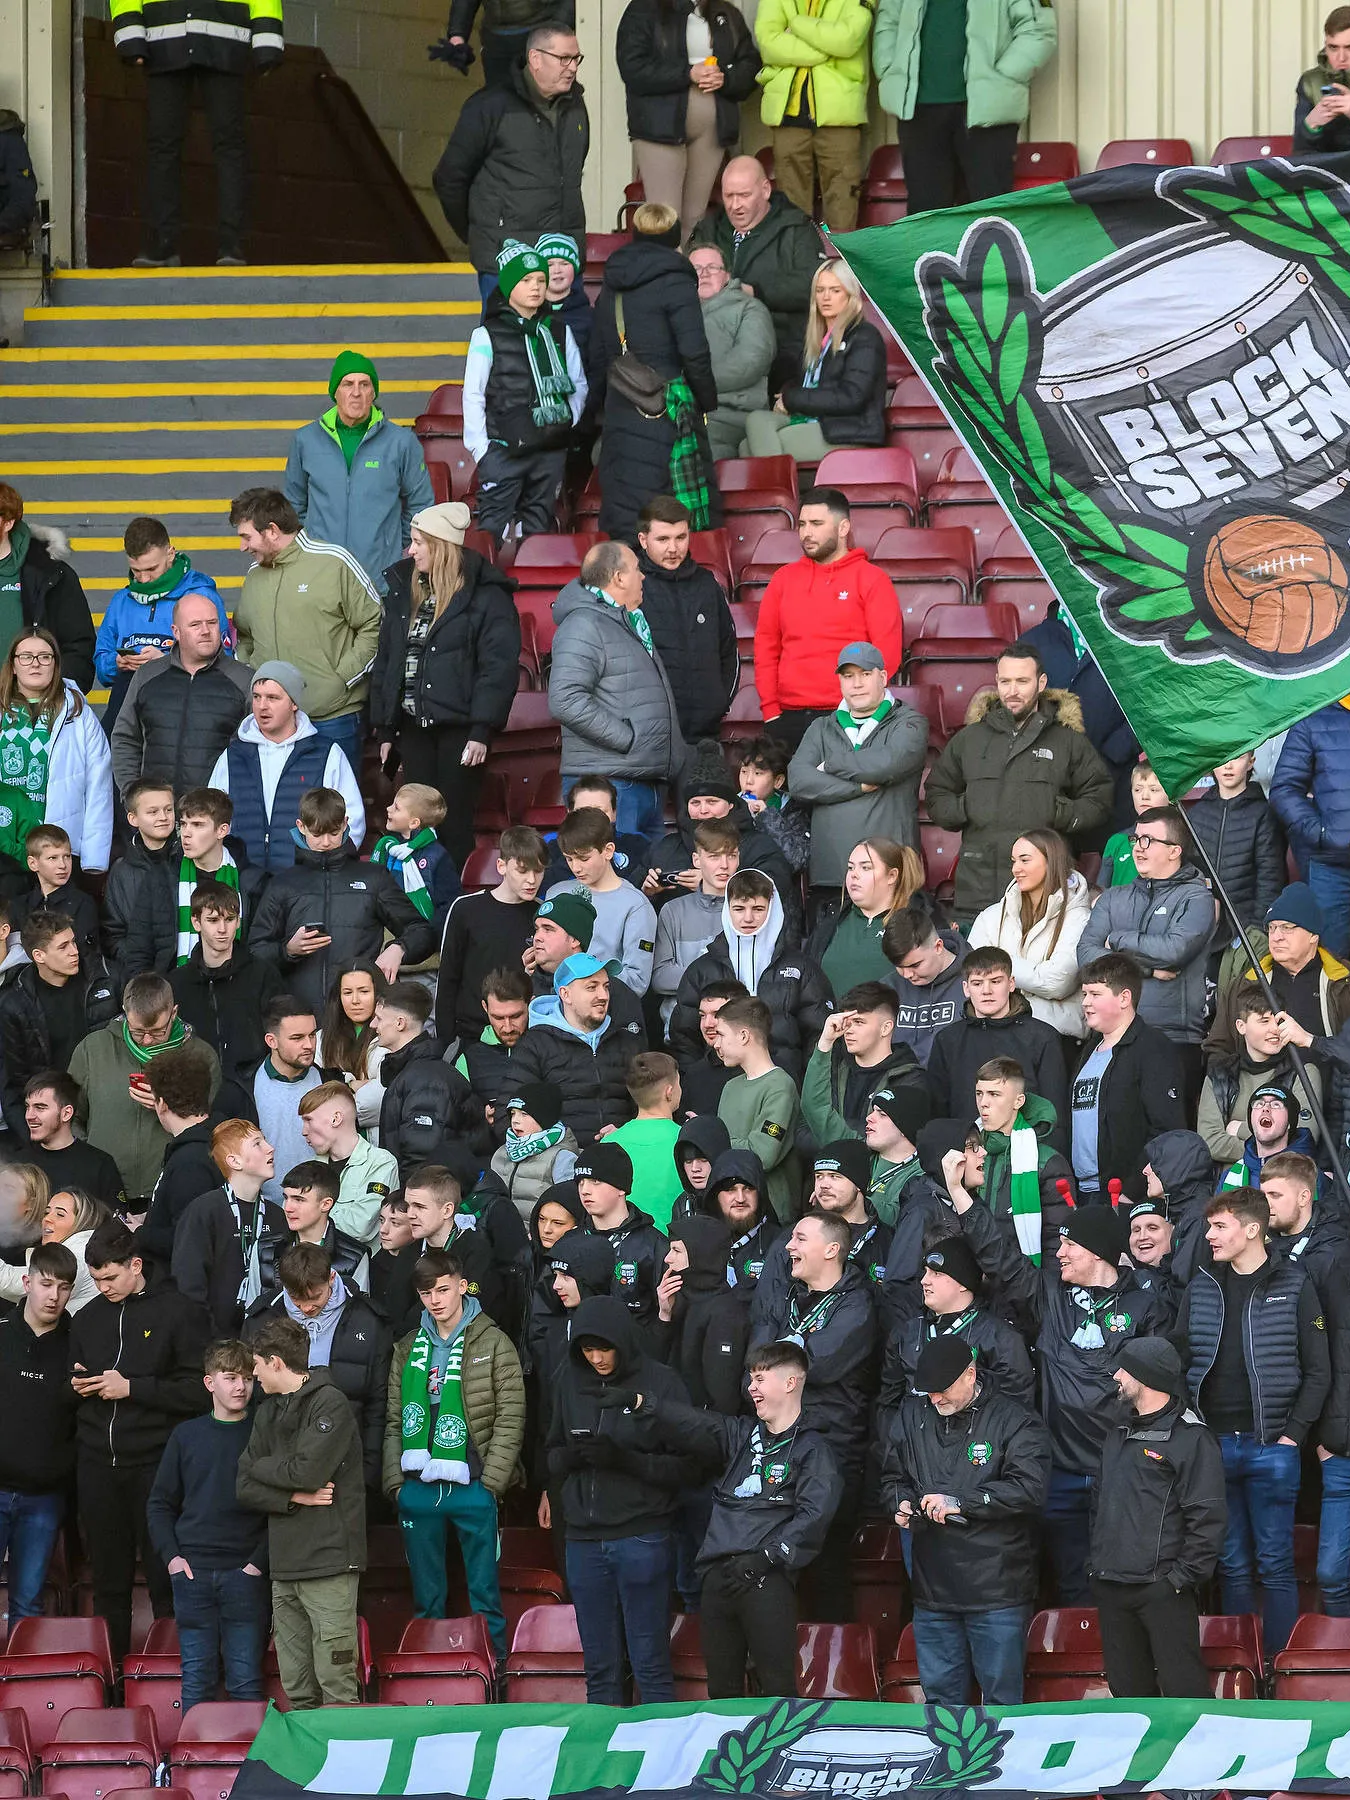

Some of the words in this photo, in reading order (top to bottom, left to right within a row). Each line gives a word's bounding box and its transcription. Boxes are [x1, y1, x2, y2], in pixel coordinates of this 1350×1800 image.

[1100, 321, 1334, 463] BLOCK
[124, 635, 161, 649] ellesse
[899, 1006, 952, 1023] NICCE
[786, 1765, 920, 1789] BLOCK
